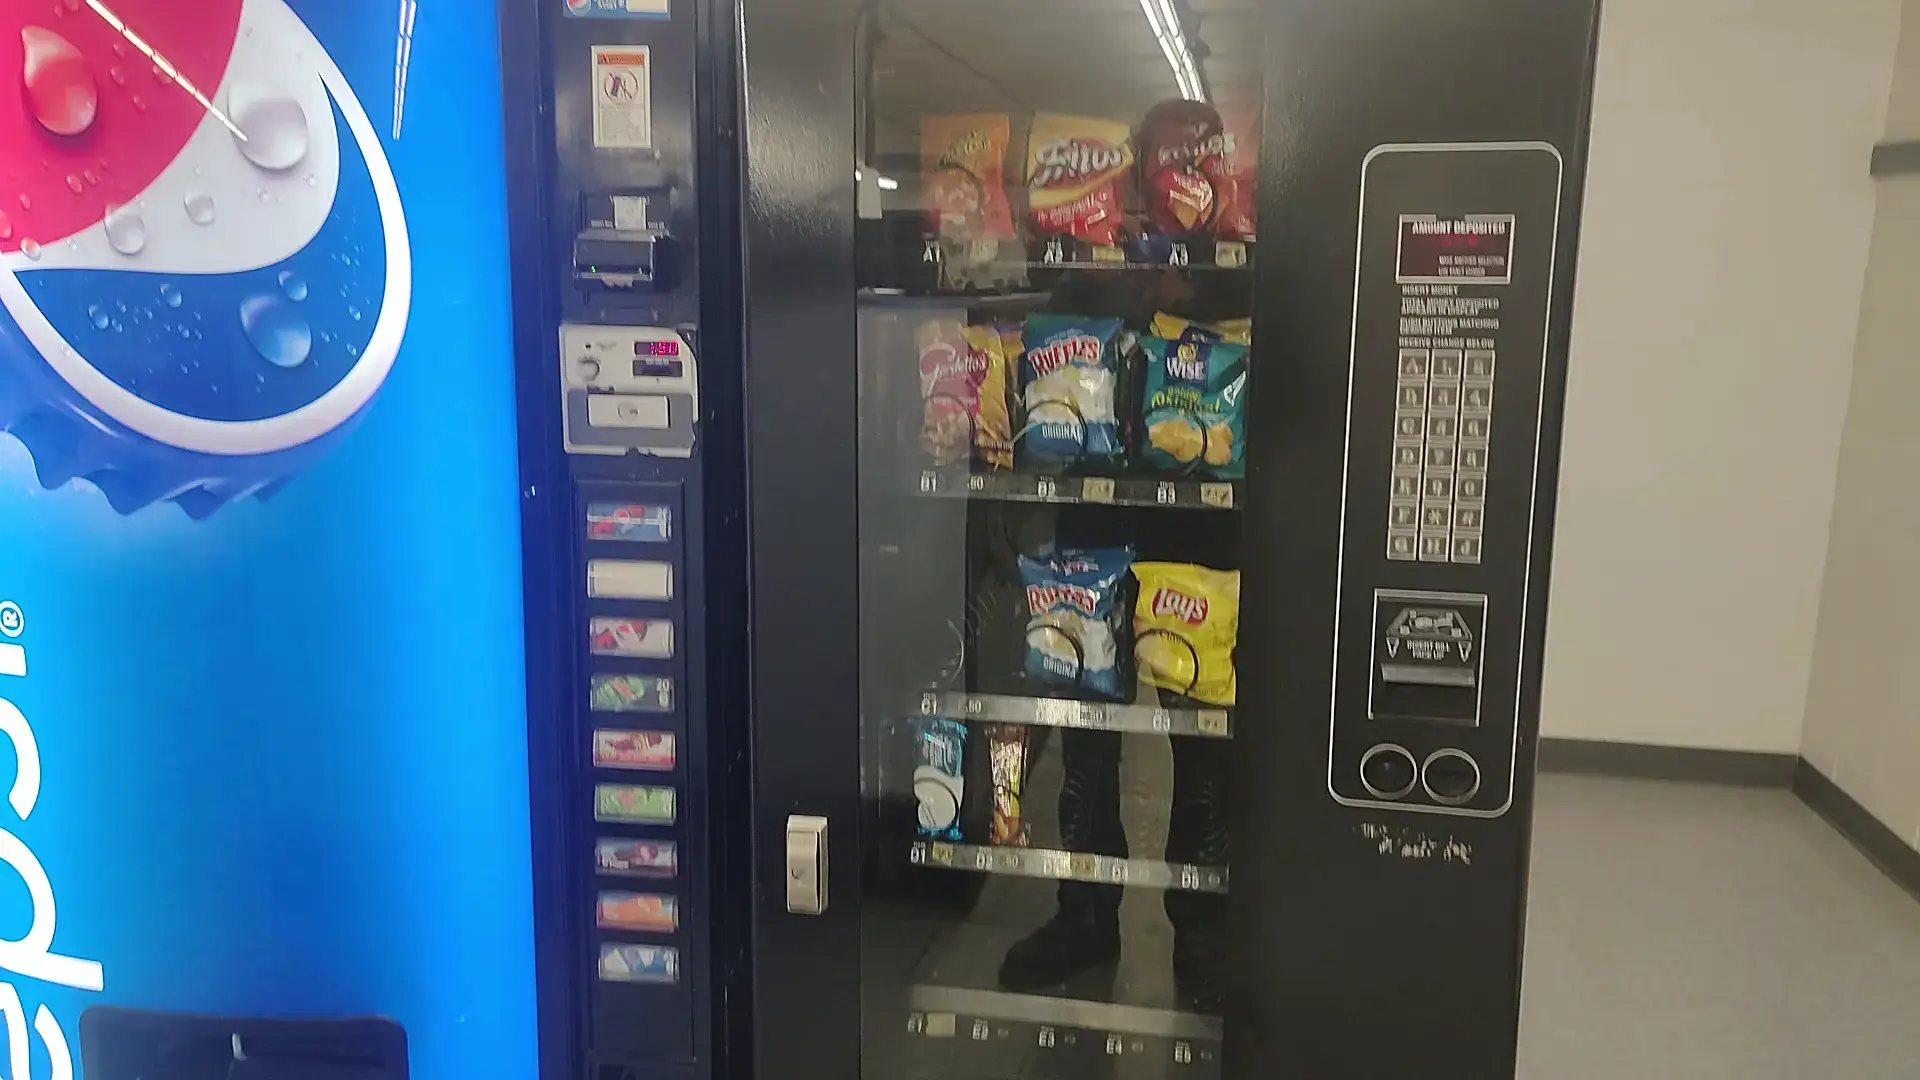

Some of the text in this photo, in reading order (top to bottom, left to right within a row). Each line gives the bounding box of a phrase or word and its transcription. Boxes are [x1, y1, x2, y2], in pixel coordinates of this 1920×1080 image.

[1412, 220, 1505, 235] AMOUNT DEPOSITED
[1027, 334, 1101, 380] RUFFLES
[1166, 356, 1205, 381] WISE
[1044, 655, 1078, 680] ORIGINA
